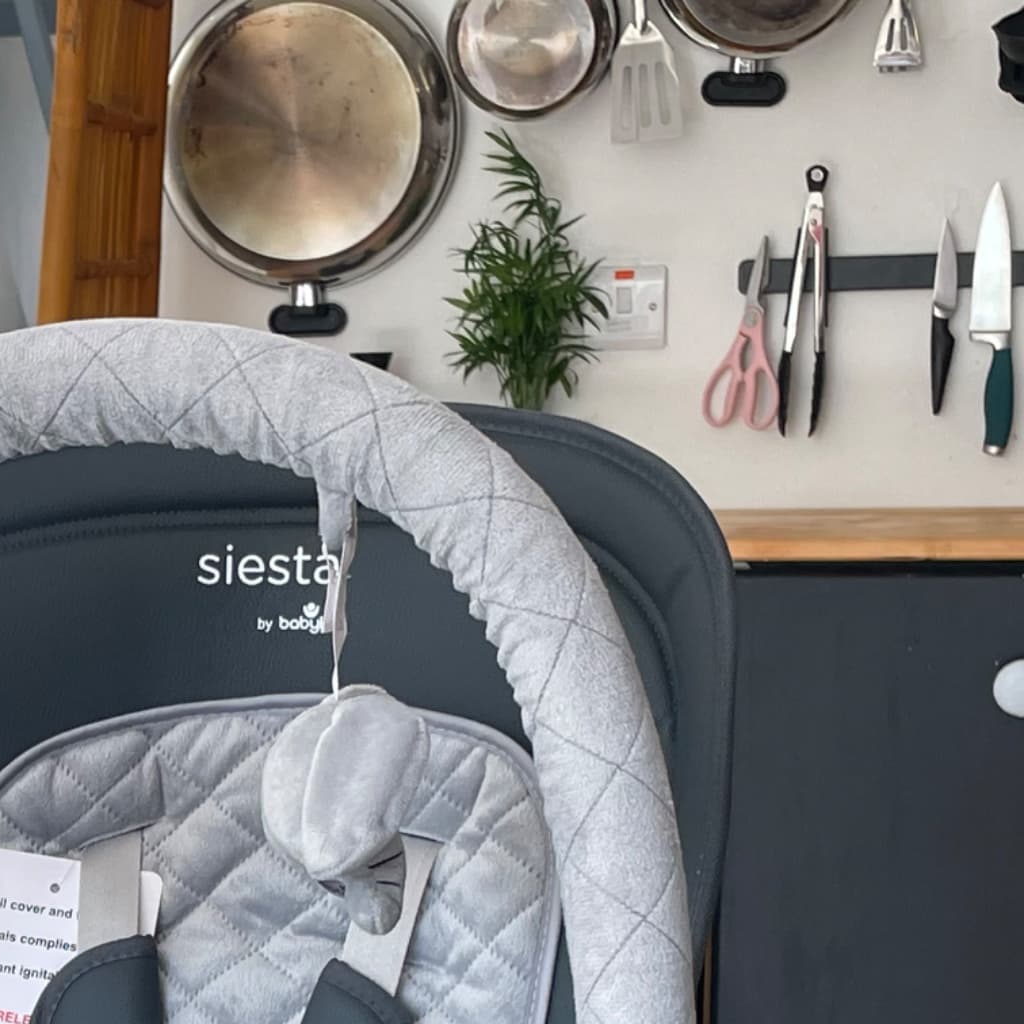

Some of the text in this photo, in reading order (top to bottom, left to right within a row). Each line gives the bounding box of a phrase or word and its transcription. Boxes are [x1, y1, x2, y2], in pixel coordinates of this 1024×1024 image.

[197, 544, 340, 586] siesta
[257, 617, 273, 633] by
[10, 901, 45, 915] cover
[48, 906, 73, 919] and
[20, 934, 77, 952] complies
[19, 965, 59, 981] ignita
